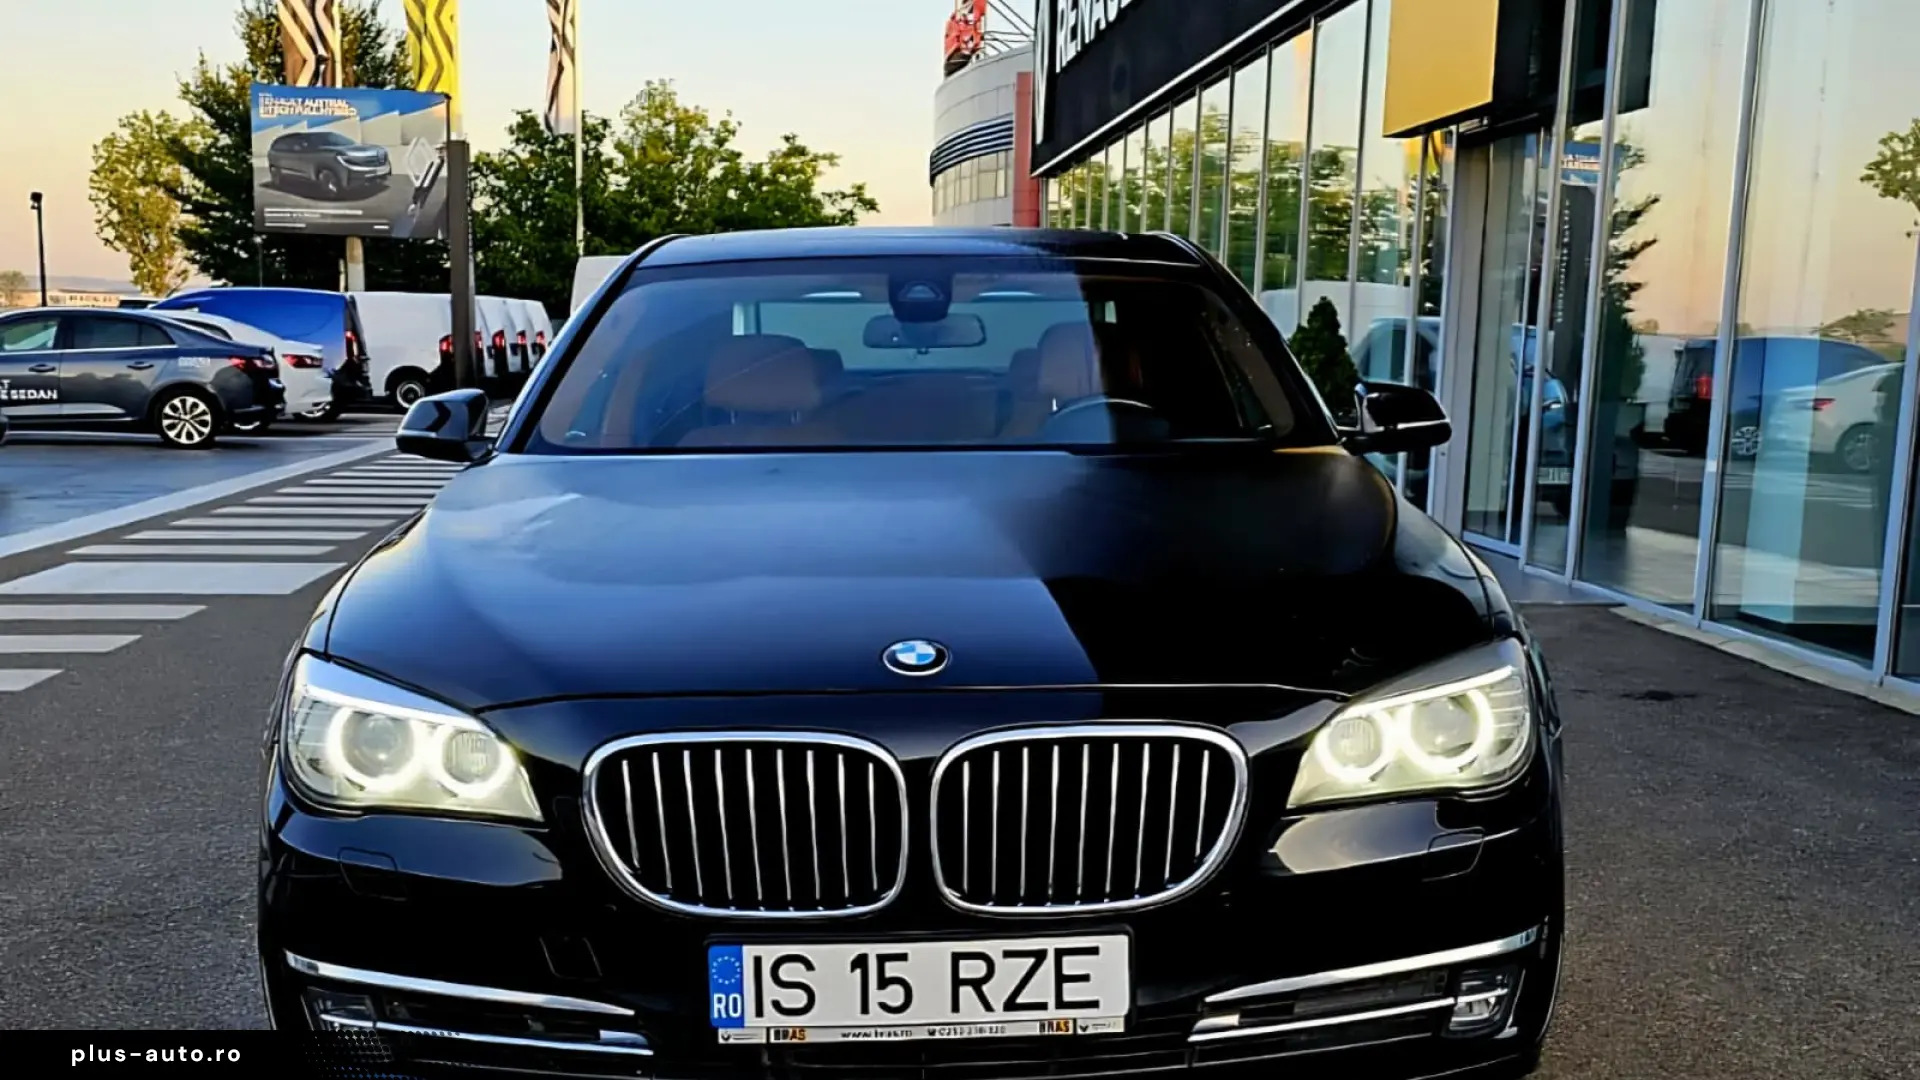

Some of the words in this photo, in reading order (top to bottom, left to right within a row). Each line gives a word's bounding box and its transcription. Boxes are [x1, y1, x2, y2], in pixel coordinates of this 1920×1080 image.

[11, 389, 58, 400] SEDAN
[752, 954, 816, 1018] IS
[850, 952, 913, 1015] 15
[950, 946, 1100, 1013] RZE
[714, 993, 742, 1018] RO
